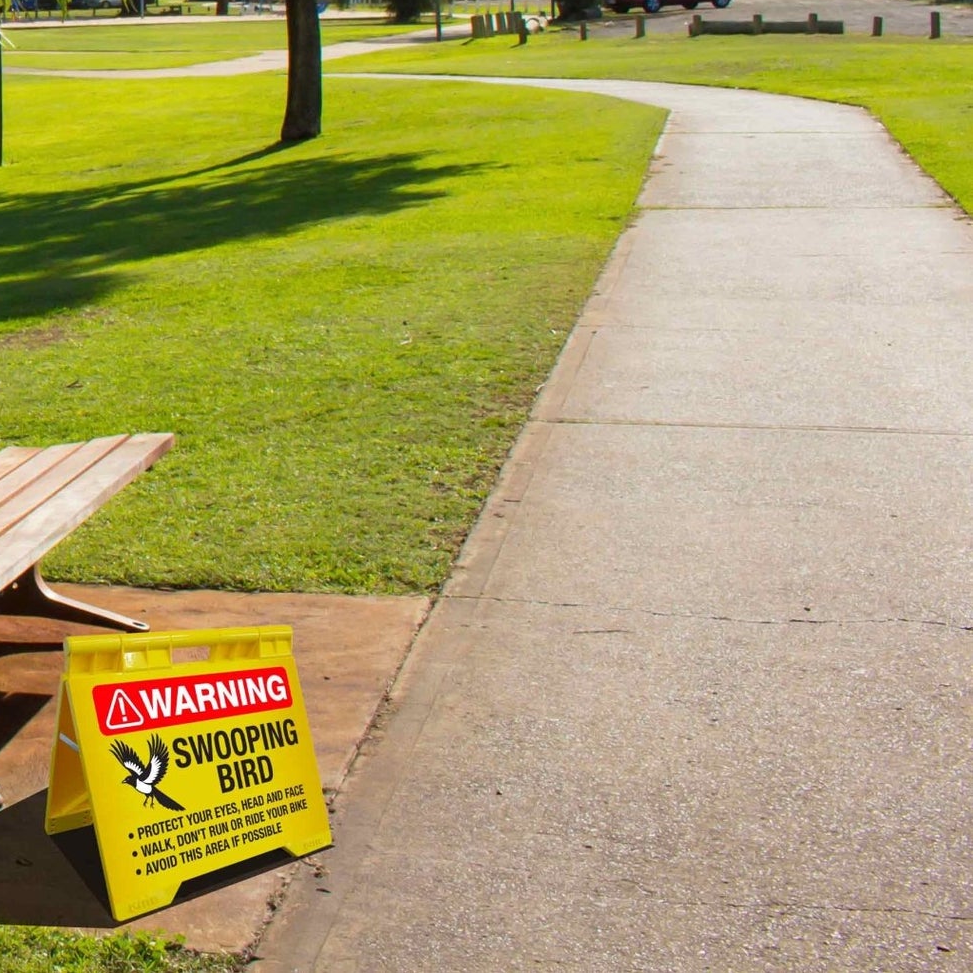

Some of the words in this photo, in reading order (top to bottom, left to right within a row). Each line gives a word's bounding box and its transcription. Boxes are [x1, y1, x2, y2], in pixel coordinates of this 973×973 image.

[138, 674, 288, 720] WARNING
[172, 718, 299, 768] SWOOPING
[217, 755, 274, 794] BIRD
[138, 817, 184, 840] PROTECT
[186, 808, 212, 824] YOUR
[215, 802, 240, 818] EYES,
[242, 795, 264, 810] HEAD
[266, 790, 284, 804] AND
[285, 784, 304, 798] FACE
[141, 838, 176, 858] WALK,
[177, 828, 206, 847] DON'T
[210, 821, 229, 837] RUN
[230, 817, 244, 831] OR
[246, 811, 265, 826] RIDE
[266, 804, 289, 820] YOUR
[290, 799, 308, 814] BIKE
[146, 854, 178, 876] AVOID
[179, 847, 202, 864] THIS
[205, 838, 230, 856] AREA
[231, 834, 240, 847] IF
[242, 822, 282, 844] POSSIBLE
